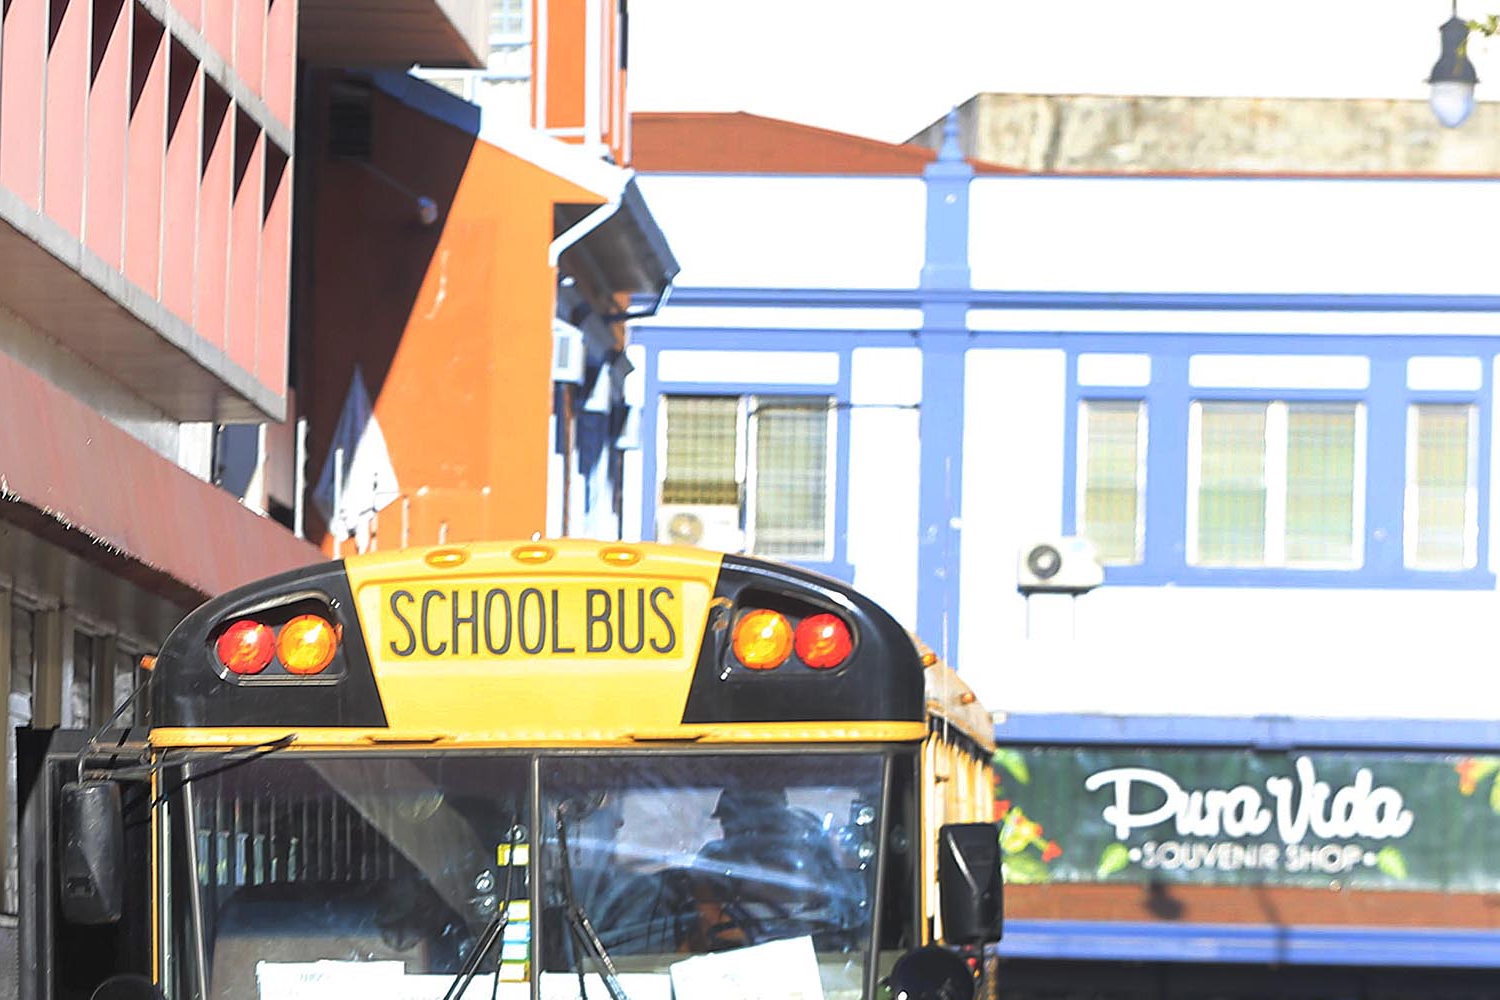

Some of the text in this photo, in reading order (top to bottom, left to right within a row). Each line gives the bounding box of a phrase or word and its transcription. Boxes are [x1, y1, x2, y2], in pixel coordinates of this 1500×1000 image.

[389, 586, 677, 657] SCHOOL BUS
[1085, 755, 1414, 845] Pura Vida
[1141, 841, 1364, 874] SOUVENIR SHOP
